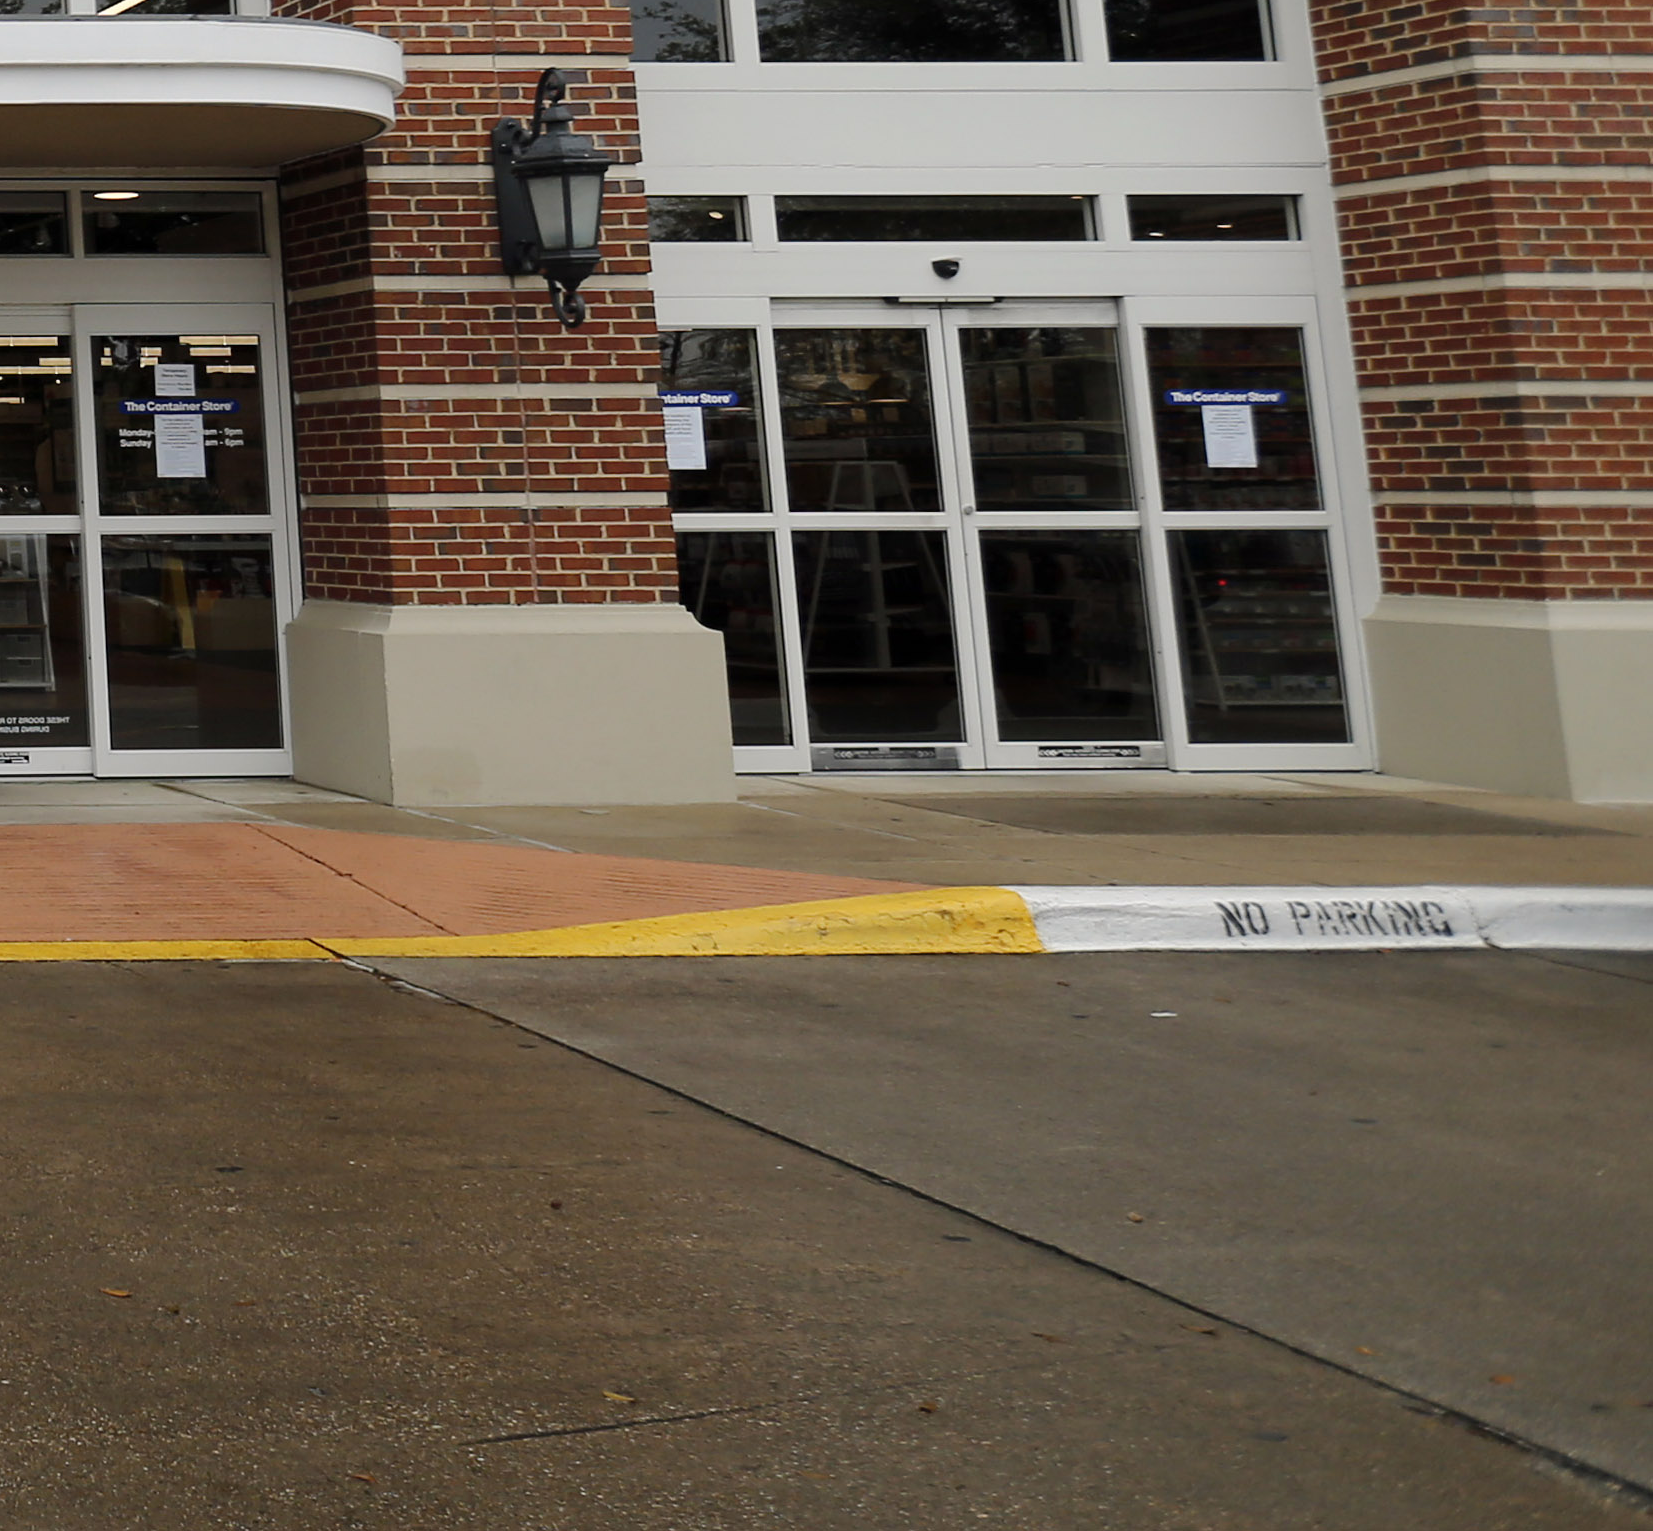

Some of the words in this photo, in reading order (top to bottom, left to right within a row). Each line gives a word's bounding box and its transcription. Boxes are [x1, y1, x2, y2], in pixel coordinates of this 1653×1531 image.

[700, 393, 731, 404] Store
[1170, 392, 1192, 402] The
[1193, 391, 1247, 402] Container
[1248, 392, 1279, 402] Store
[124, 401, 145, 411] The
[146, 401, 201, 411] Container
[202, 401, 232, 411] Store
[120, 439, 152, 449] Sunday
[1214, 901, 1270, 938] NO
[1285, 901, 1455, 937] PARKING
